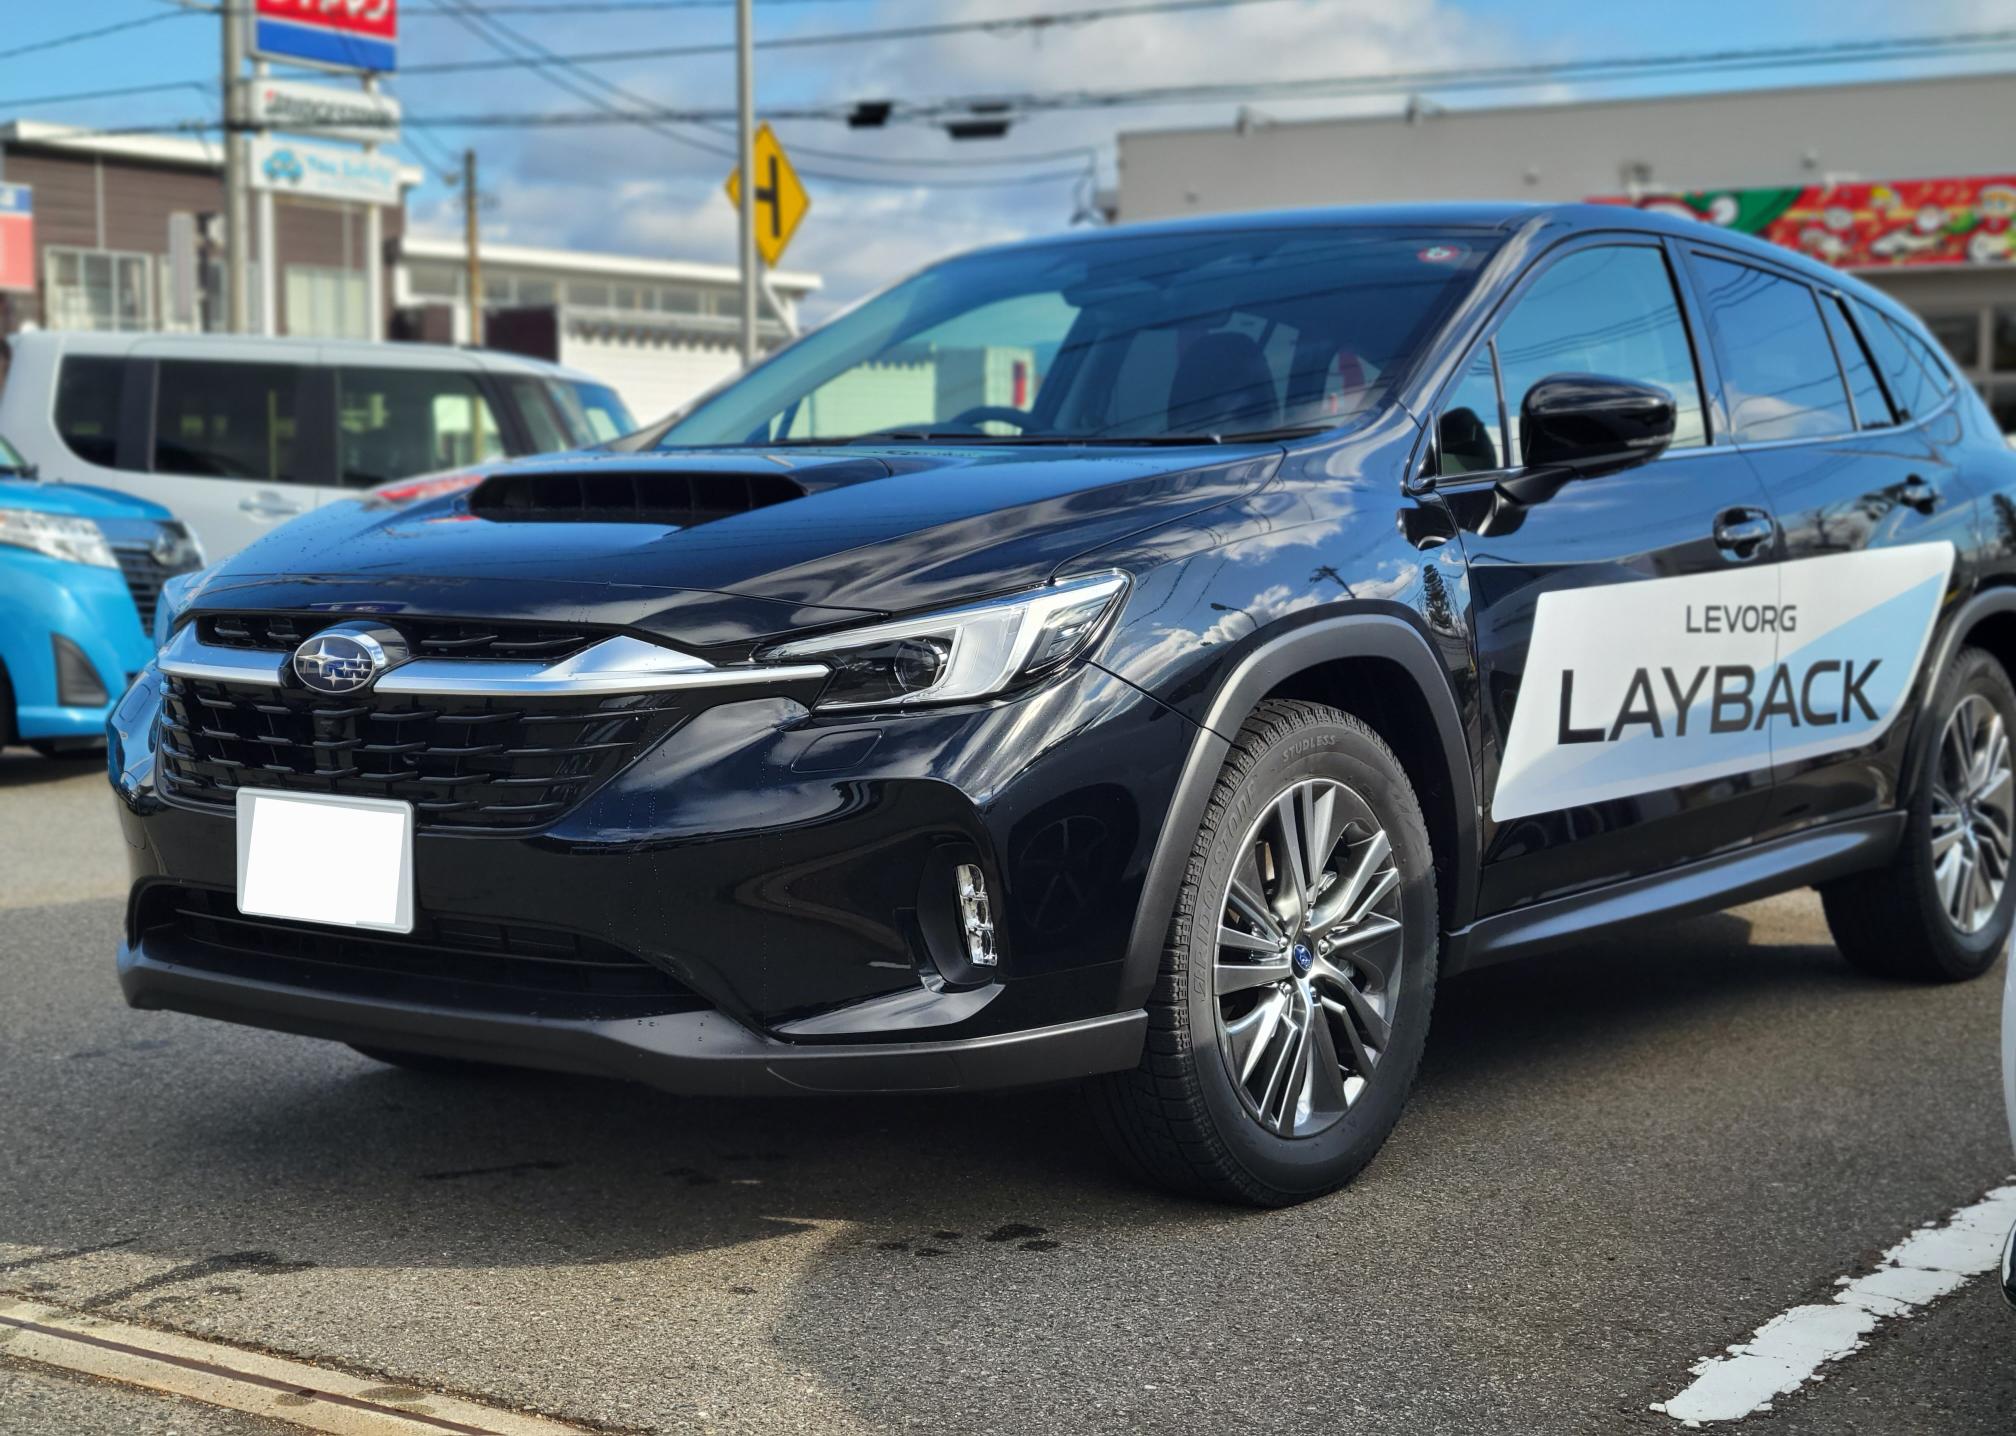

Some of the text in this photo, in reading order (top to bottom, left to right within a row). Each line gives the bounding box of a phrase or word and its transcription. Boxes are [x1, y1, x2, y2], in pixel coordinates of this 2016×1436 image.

[1686, 604, 1796, 633] LEVORG
[1557, 658, 1883, 746] LAYBACK
[1282, 734, 1337, 763] STUDLESS
